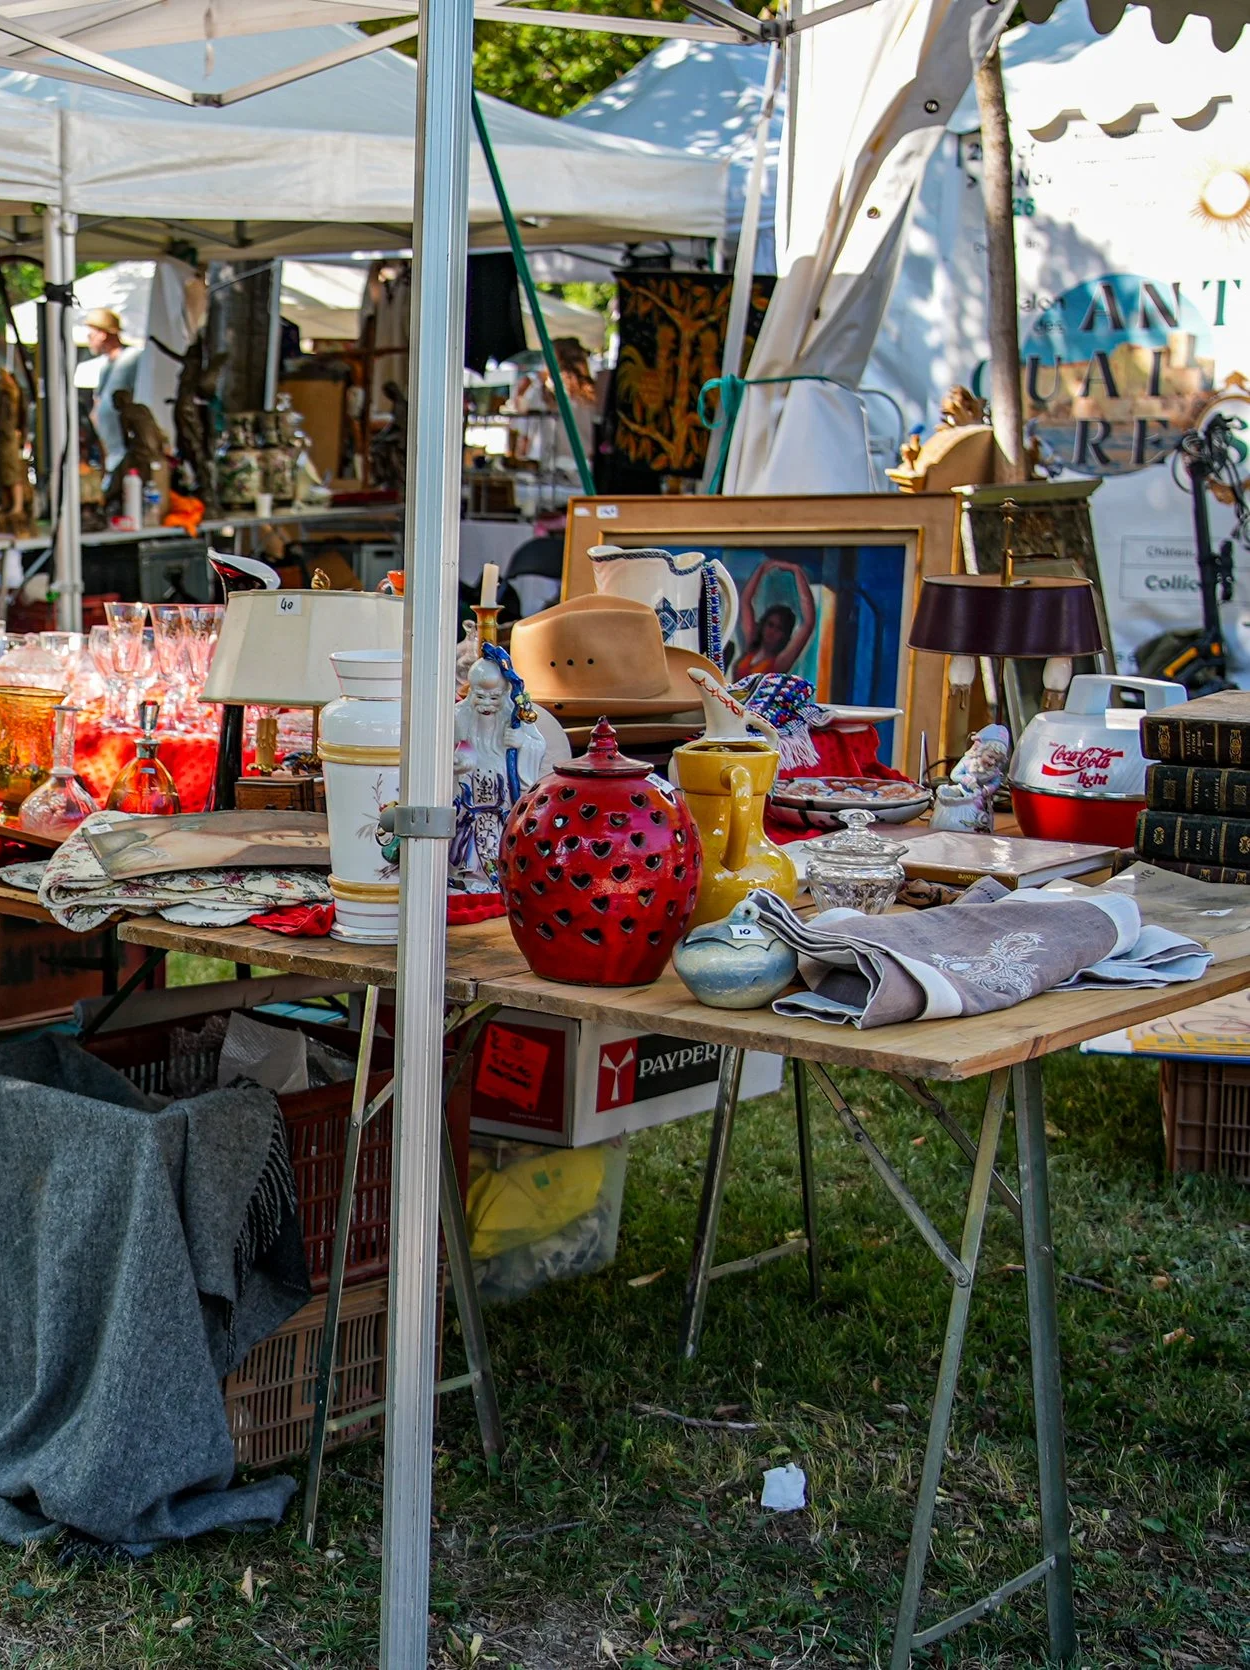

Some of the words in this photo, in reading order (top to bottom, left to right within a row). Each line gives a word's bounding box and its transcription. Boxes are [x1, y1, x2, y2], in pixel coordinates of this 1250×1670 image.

[1020, 294, 1066, 312] alon
[1034, 316, 1066, 334] des
[1145, 573, 1200, 593] Collio
[280, 597, 294, 612] 40
[1077, 771, 1109, 788] light
[739, 928, 751, 936] 10
[638, 1043, 718, 1079] PAYPER
